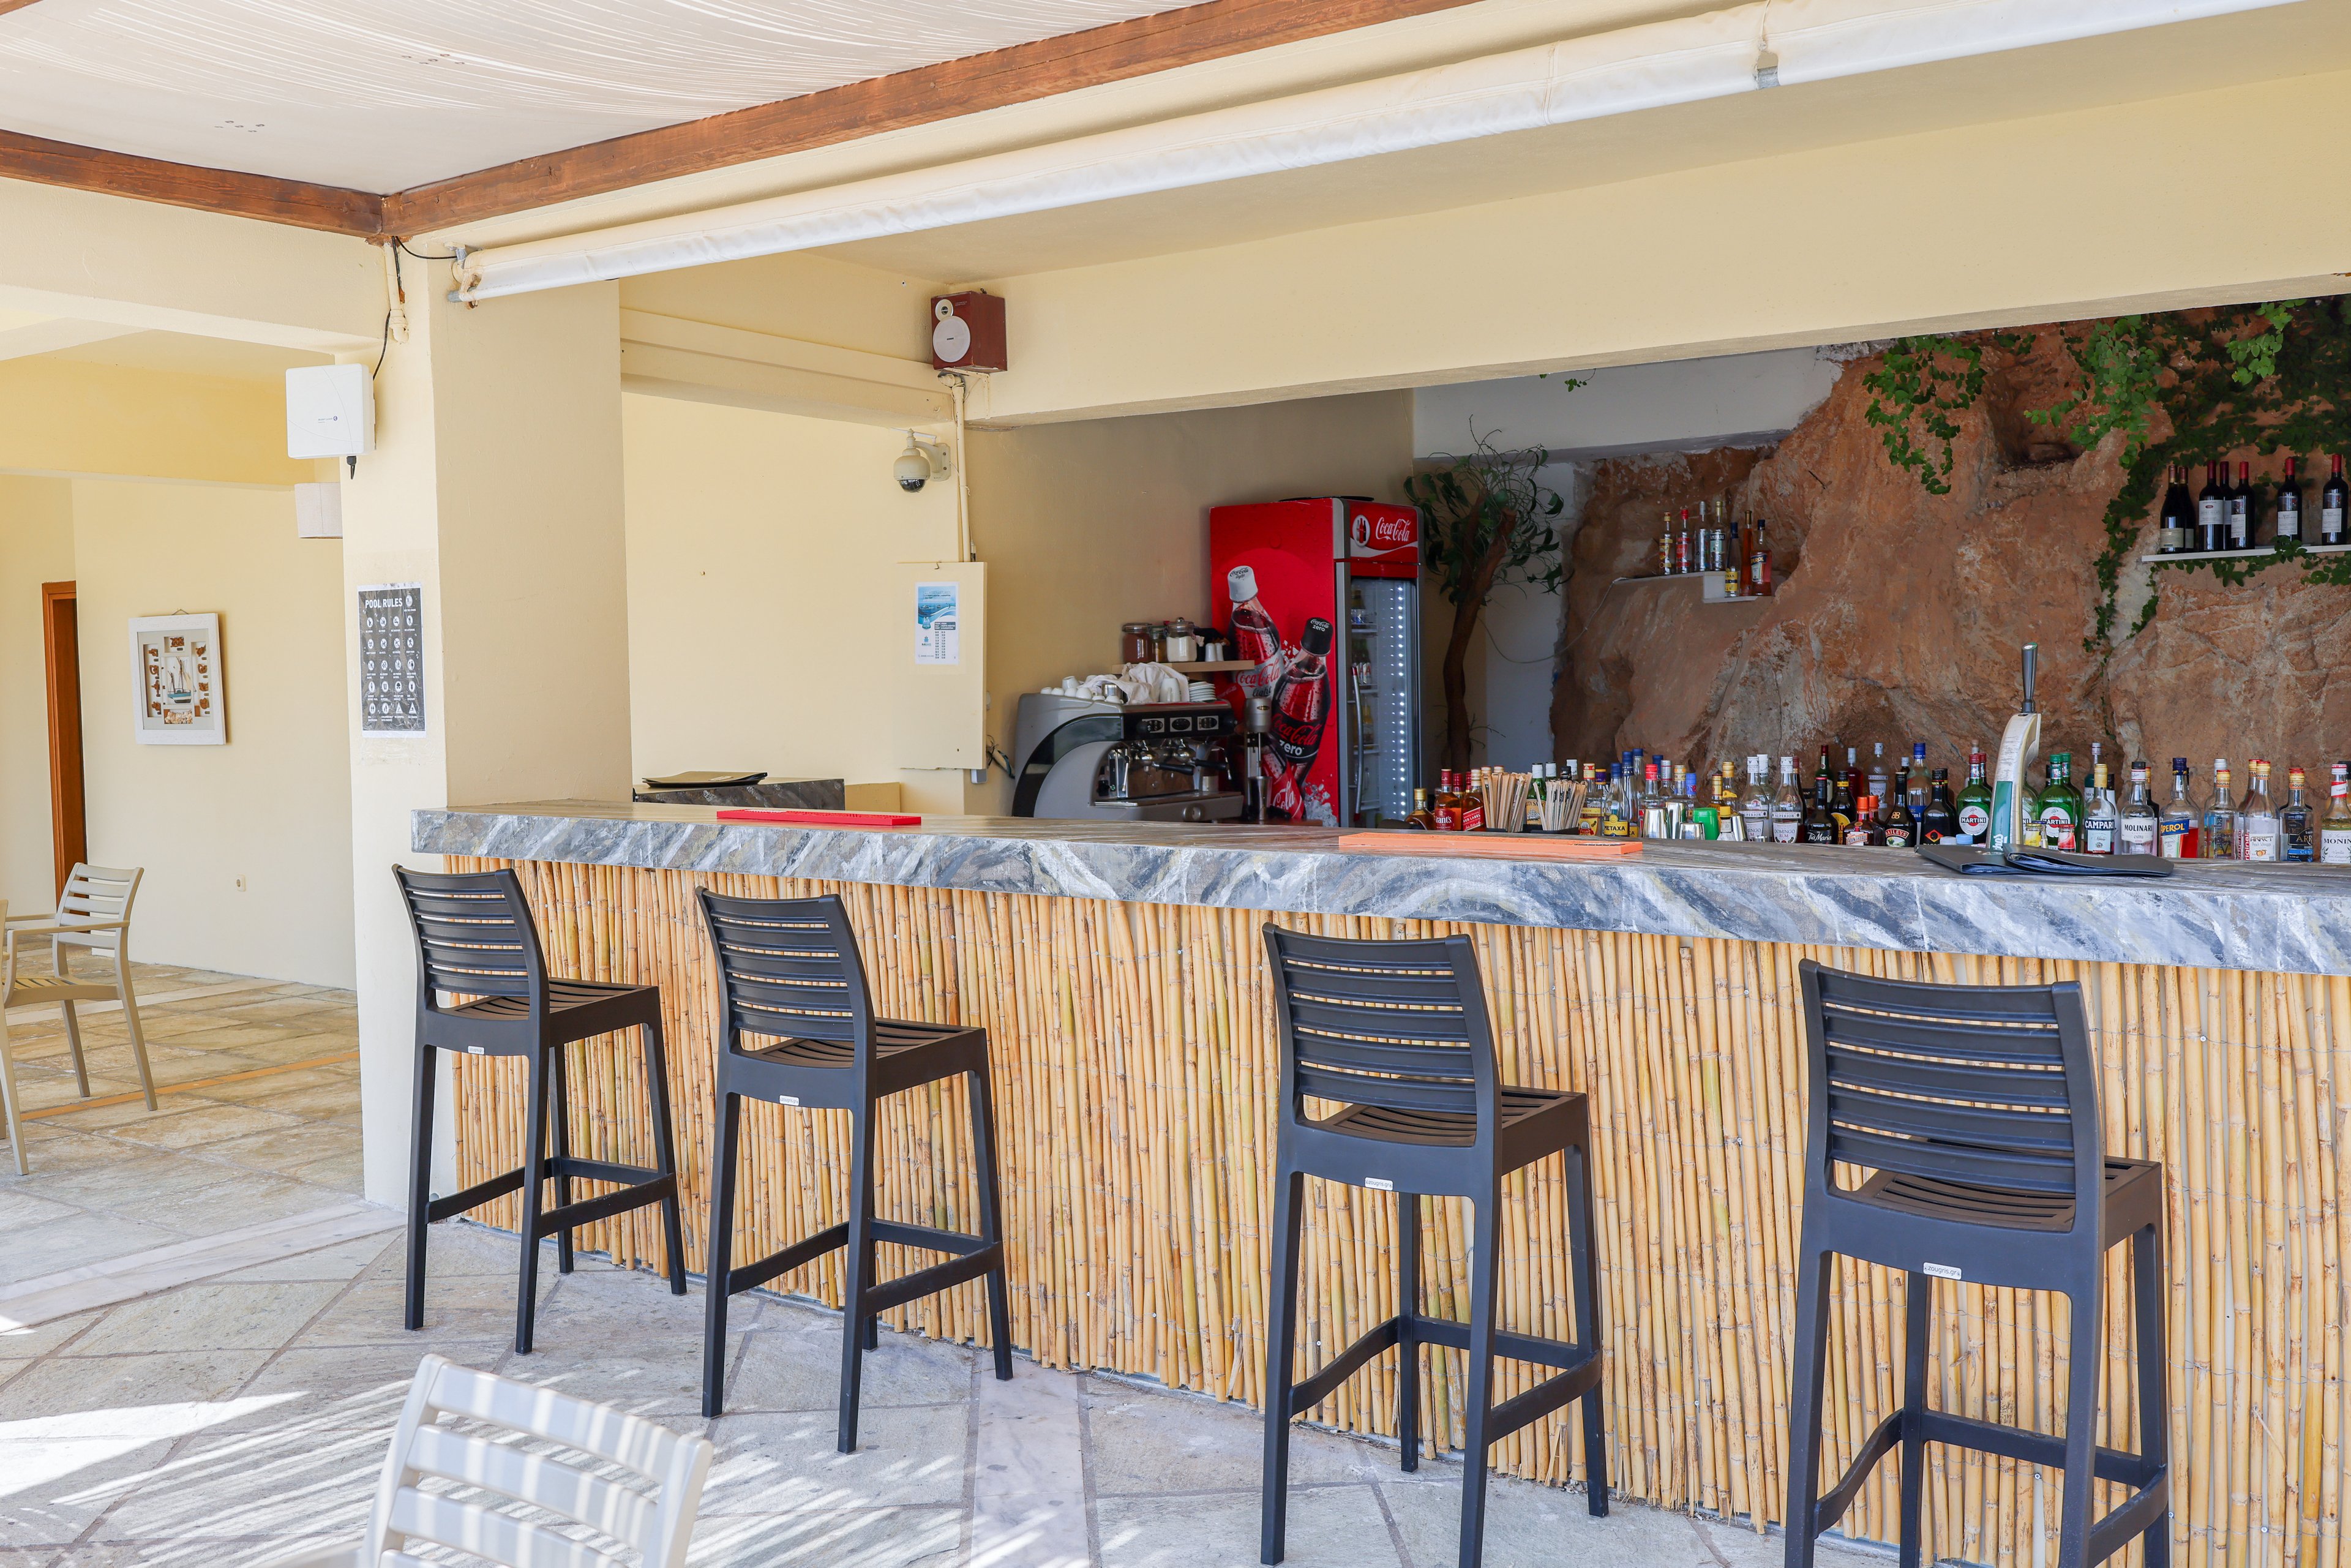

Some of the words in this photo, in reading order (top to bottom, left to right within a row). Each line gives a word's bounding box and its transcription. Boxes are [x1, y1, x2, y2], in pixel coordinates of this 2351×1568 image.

[1375, 517, 1411, 542] Coca-Cola
[365, 599, 381, 609] POOL
[382, 598, 403, 608] RULES
[1310, 618, 1330, 628] Coca-Cola
[1235, 658, 1280, 688] Coca-Cola
[1272, 713, 1323, 745] Coca-Cola
[2085, 820, 2114, 829] CAMPARI
[2161, 823, 2185, 833] APEROL
[1814, 833, 1832, 841] Maria
[1885, 829, 1908, 839] BAILEYS
[1368, 1179, 1390, 1188] zougris.gr
[1927, 1265, 1957, 1277] zougris.gr
